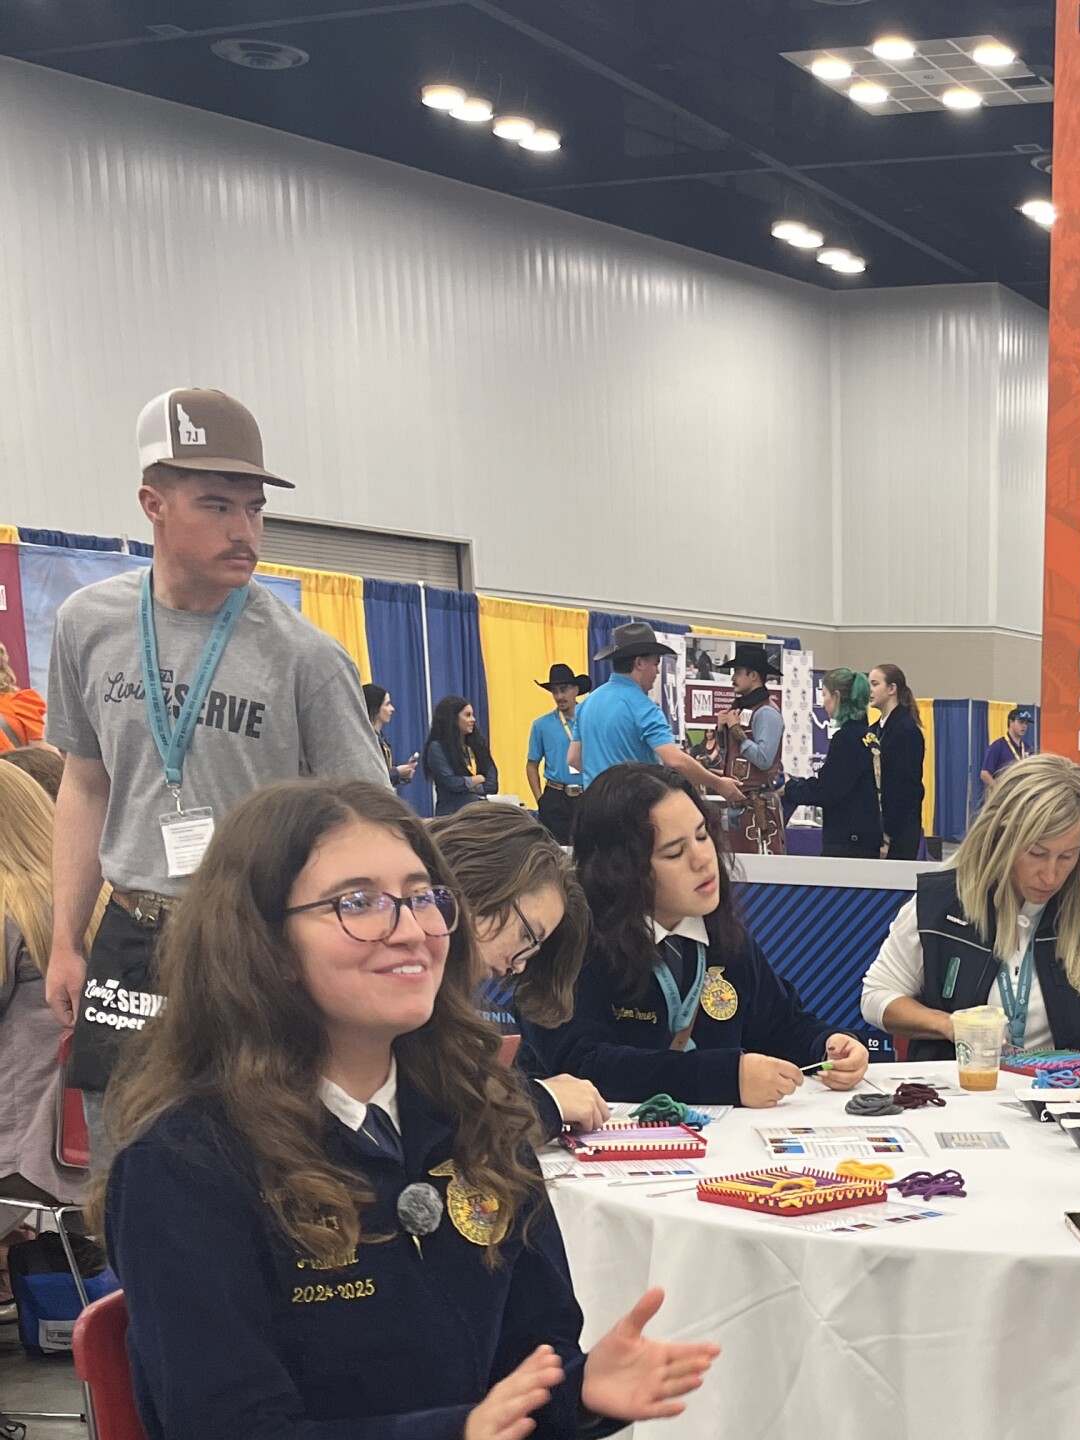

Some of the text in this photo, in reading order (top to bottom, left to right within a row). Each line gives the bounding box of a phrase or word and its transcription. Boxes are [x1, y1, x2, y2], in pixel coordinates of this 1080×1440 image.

[104, 672, 265, 739] Livig SRVE
[693, 693, 711, 705] NM
[85, 1006, 145, 1031] Cooper
[868, 1038, 879, 1047] to
[292, 1279, 376, 1303] 2024-2025
